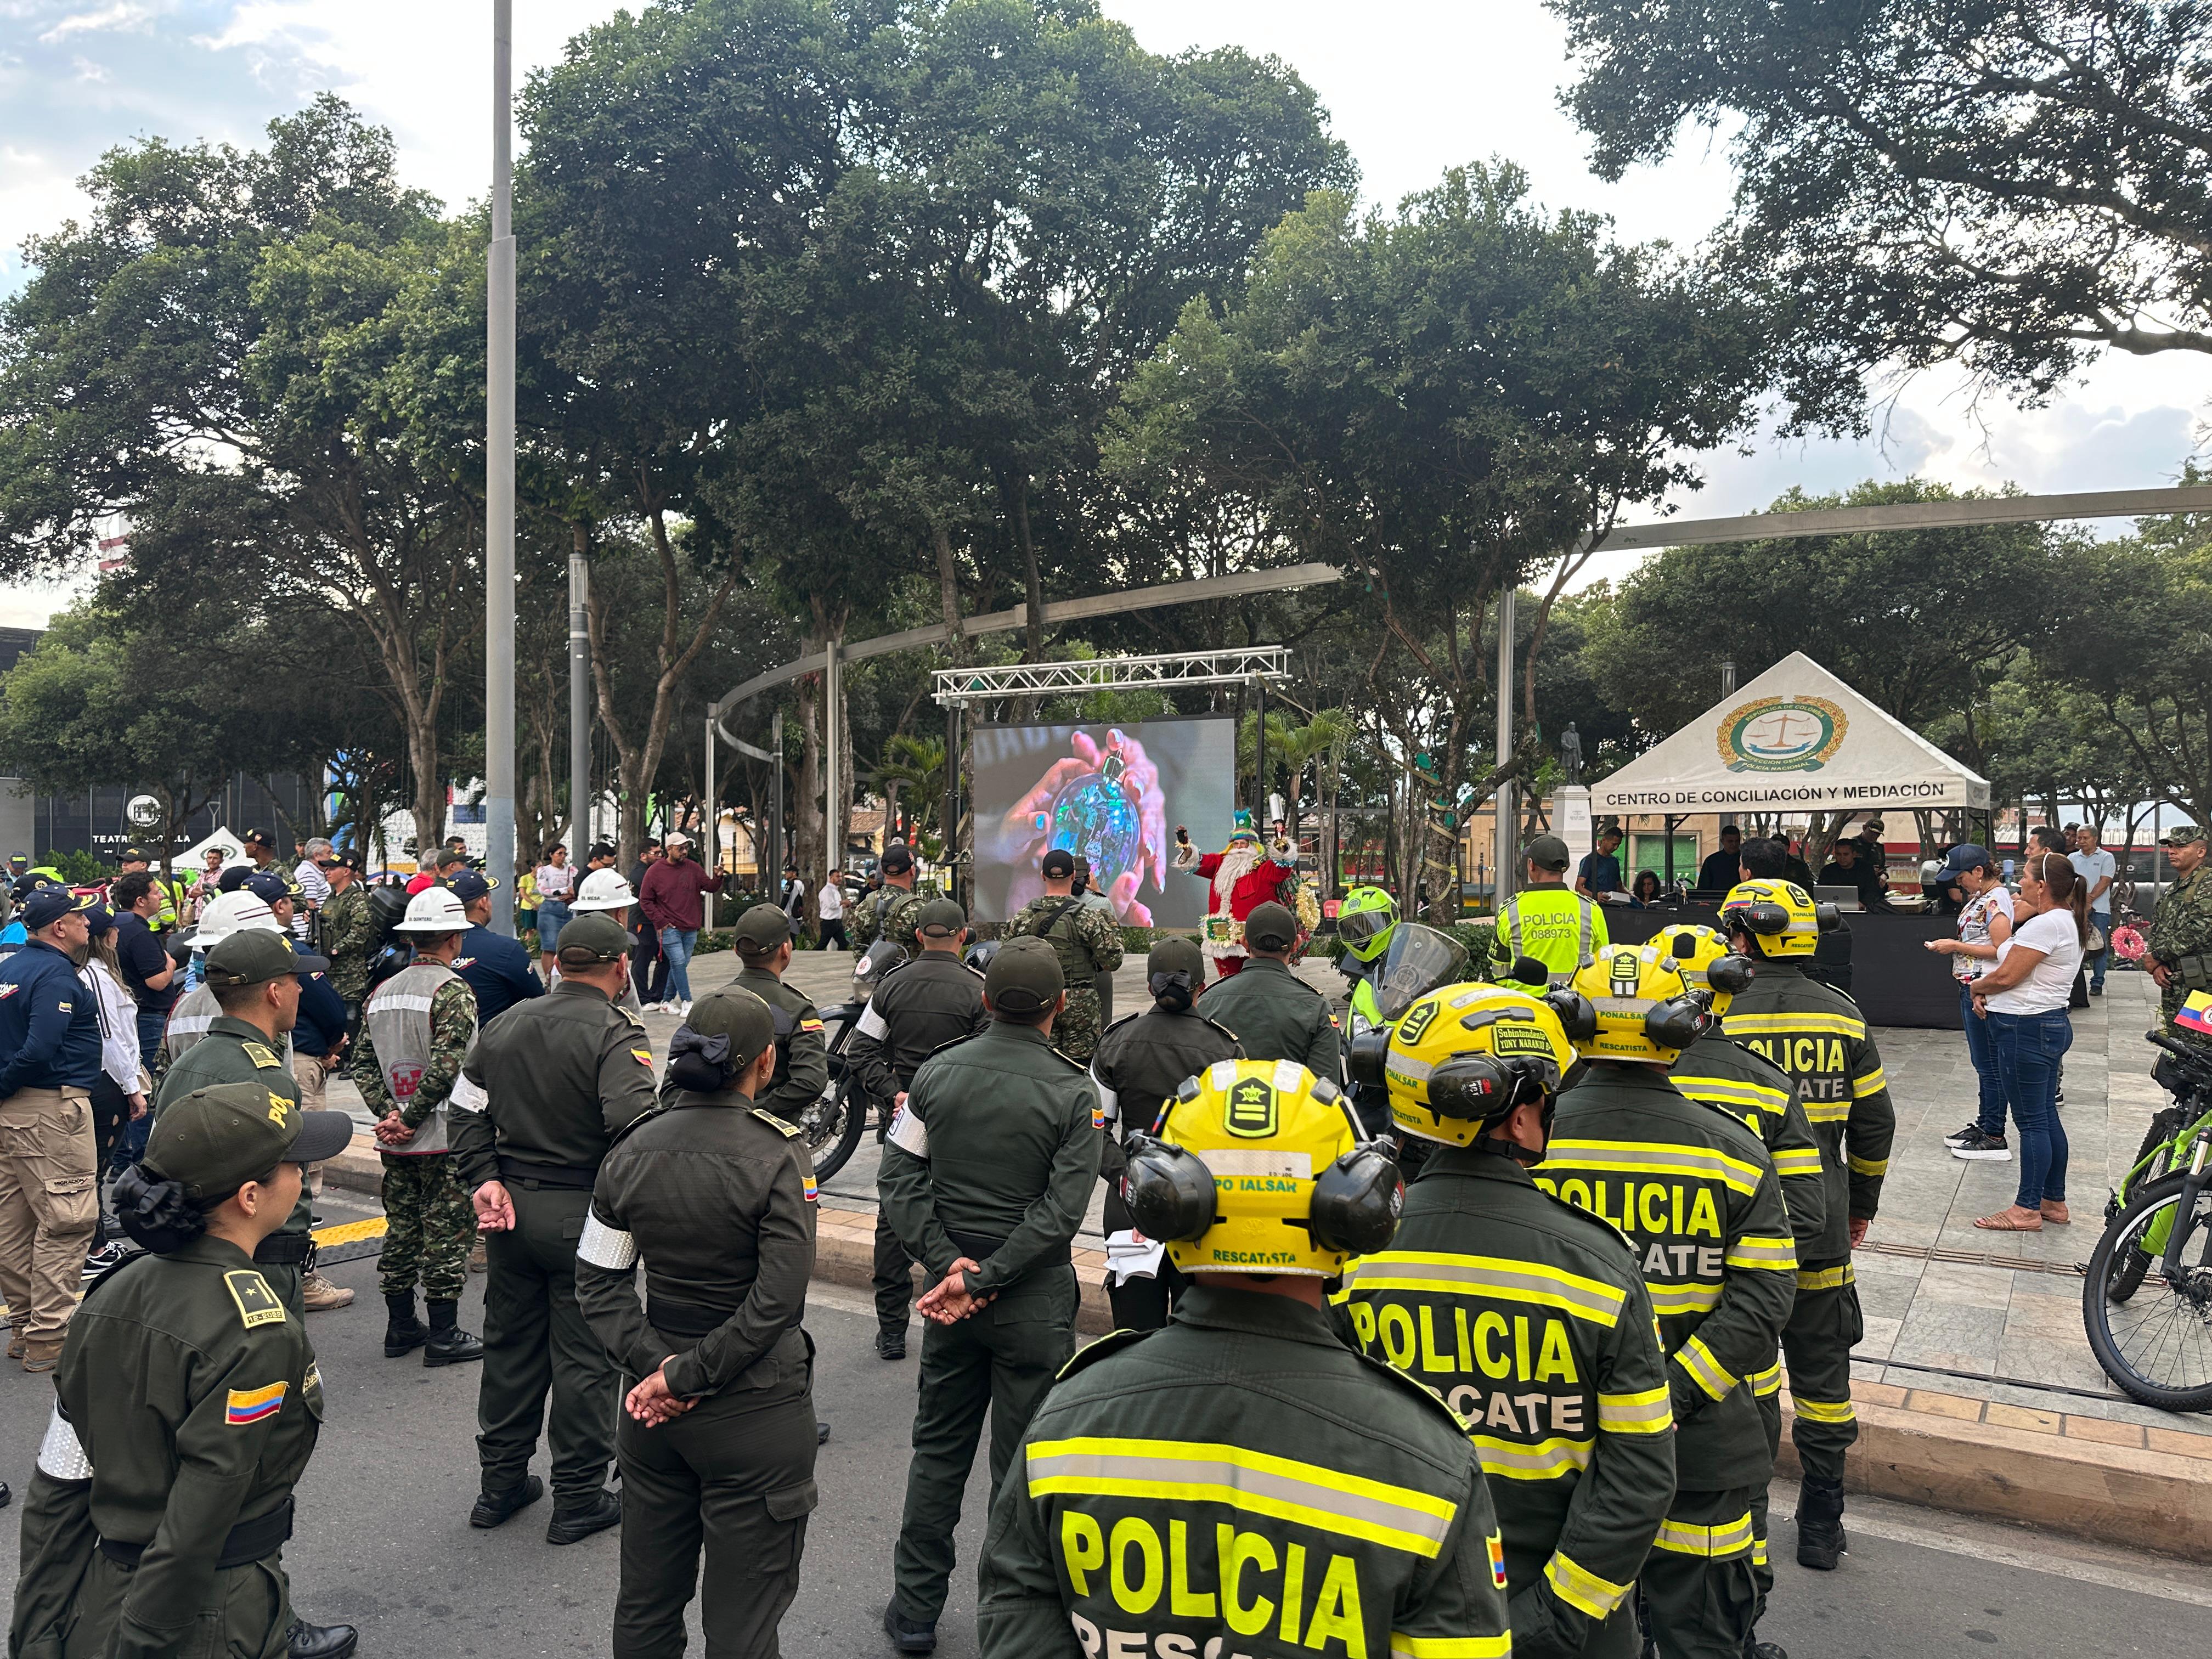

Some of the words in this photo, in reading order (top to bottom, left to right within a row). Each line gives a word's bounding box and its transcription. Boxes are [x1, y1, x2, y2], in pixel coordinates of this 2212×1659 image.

[1795, 704, 1825, 719] COLOMBIA
[1783, 750, 1817, 764] GENERAL
[1770, 761, 1812, 771] NACIONAL
[1606, 792, 1670, 806] CENTRO
[1675, 791, 1697, 804] DE
[1701, 785, 1821, 803] CONCILIACIÓN
[1826, 787, 1837, 799] Y
[1843, 781, 1944, 798] MEDIACIÓN
[1522, 912, 1577, 928] POLICIA
[1531, 928, 1571, 940] 088973
[1499, 1039, 1517, 1049] YONY
[1599, 1042, 1647, 1052] RESCATISTA
[1213, 1249, 1296, 1264] RESCATISTA
[1347, 1301, 1578, 1384] POLICIA
[1062, 1511, 1368, 1659] POLICIA
